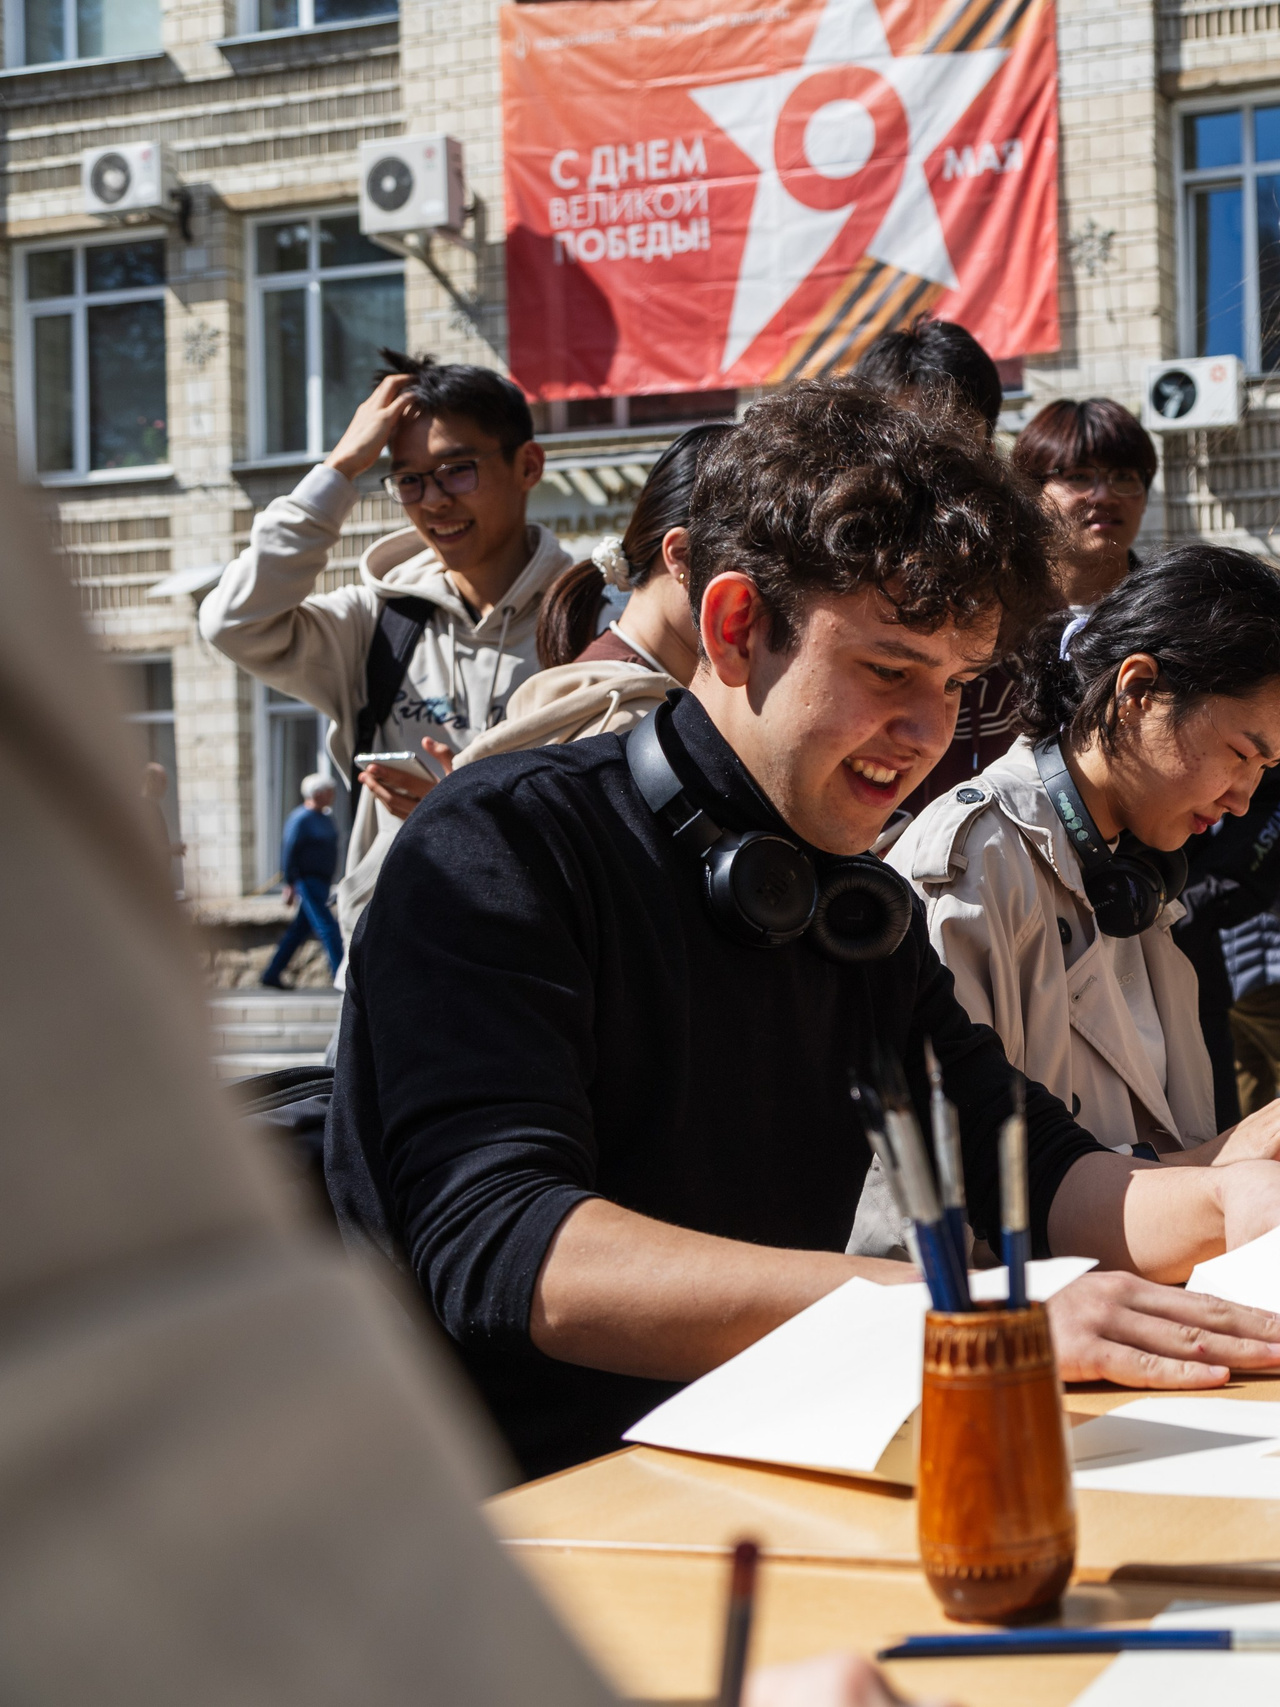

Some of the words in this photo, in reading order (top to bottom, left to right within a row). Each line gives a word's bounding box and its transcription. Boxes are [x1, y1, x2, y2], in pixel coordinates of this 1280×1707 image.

[550, 148, 580, 190] С
[586, 136, 709, 192] ДНЕМ
[774, 65, 909, 264] 9
[942, 138, 1023, 181] МАЯ
[548, 176, 710, 230] ВЕЛИКОЙ
[553, 216, 712, 266] ПОБЕДЫ!
